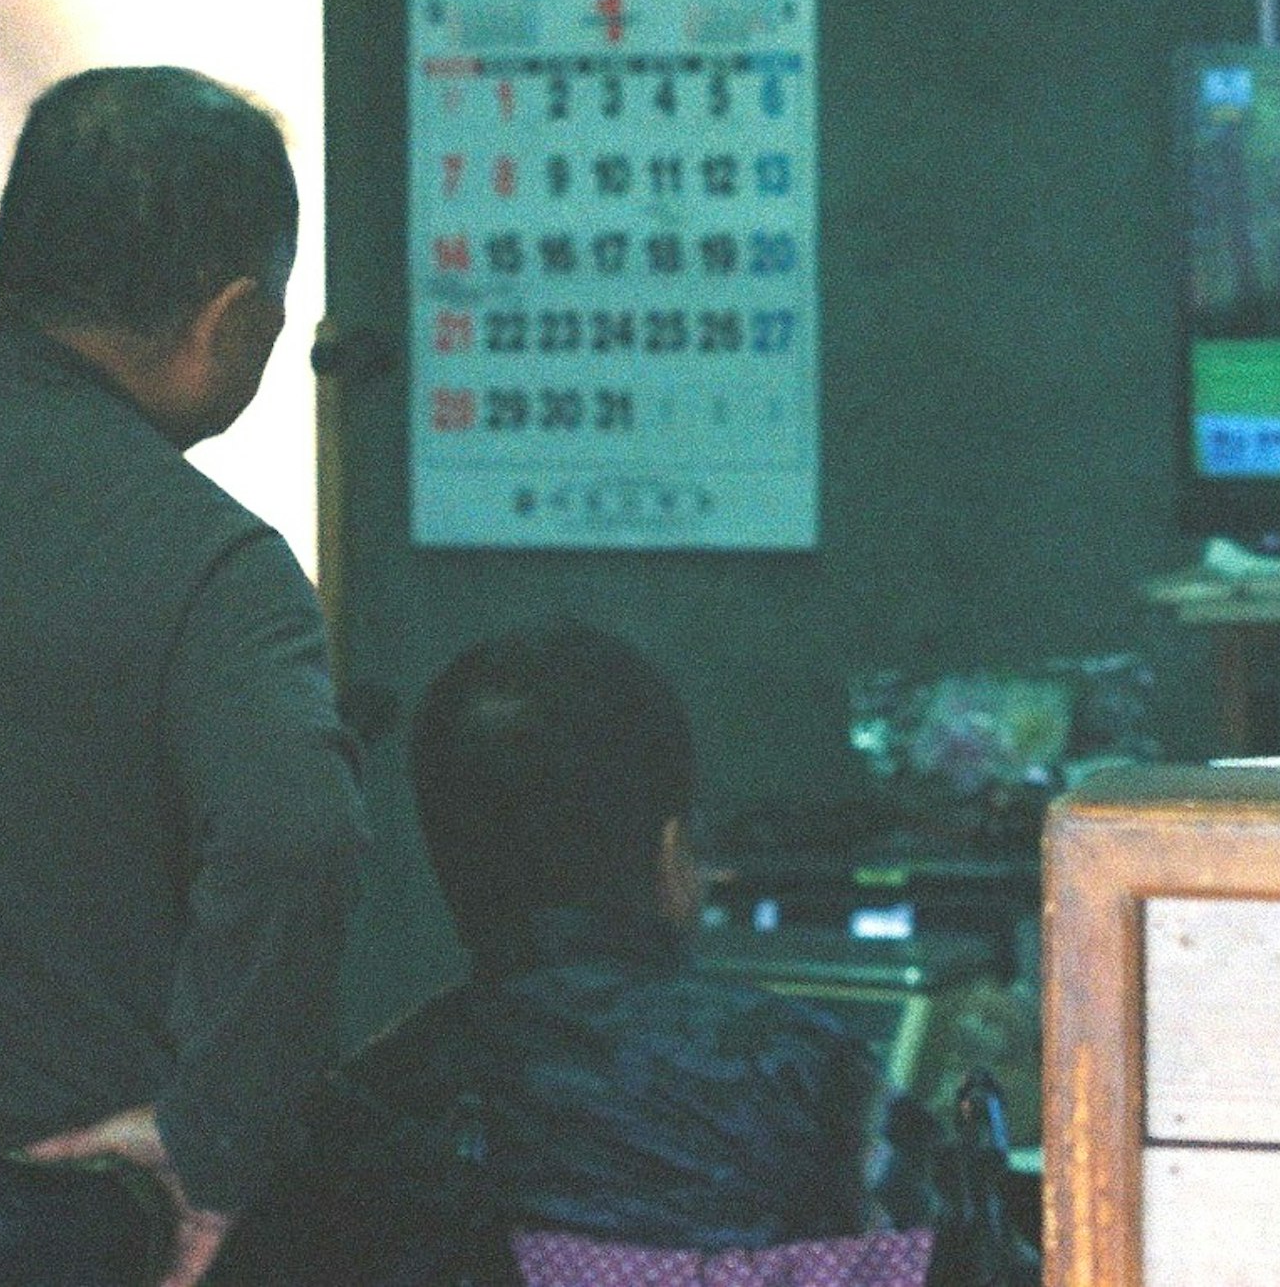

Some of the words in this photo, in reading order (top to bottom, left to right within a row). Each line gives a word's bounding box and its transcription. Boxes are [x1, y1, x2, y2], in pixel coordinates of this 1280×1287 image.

[494, 77, 516, 121] 1
[548, 76, 570, 120] 2
[600, 75, 622, 119] 3
[654, 74, 676, 116] 4
[709, 74, 730, 118] 5
[761, 74, 784, 117] 6
[443, 154, 465, 195] 7
[493, 156, 516, 197] 8
[547, 155, 570, 197] 9
[593, 156, 631, 196] 10
[648, 157, 682, 196] 11
[700, 155, 737, 196] 12
[753, 154, 791, 195] 13
[433, 234, 472, 276] 14
[485, 234, 524, 276] 15
[539, 235, 577, 274] 16
[592, 233, 629, 275] 17
[646, 234, 683, 275] 18
[699, 235, 737, 275] 19
[752, 232, 794, 276] 20
[434, 311, 472, 353] 21
[486, 312, 528, 352] 22
[538, 311, 582, 353] 23
[592, 312, 635, 353] 24
[645, 310, 688, 354] 25
[698, 312, 743, 353] 26
[751, 310, 796, 353] 27
[432, 389, 475, 431] 28
[485, 389, 530, 430] 29
[539, 389, 583, 430] 30
[596, 389, 633, 430] 31
